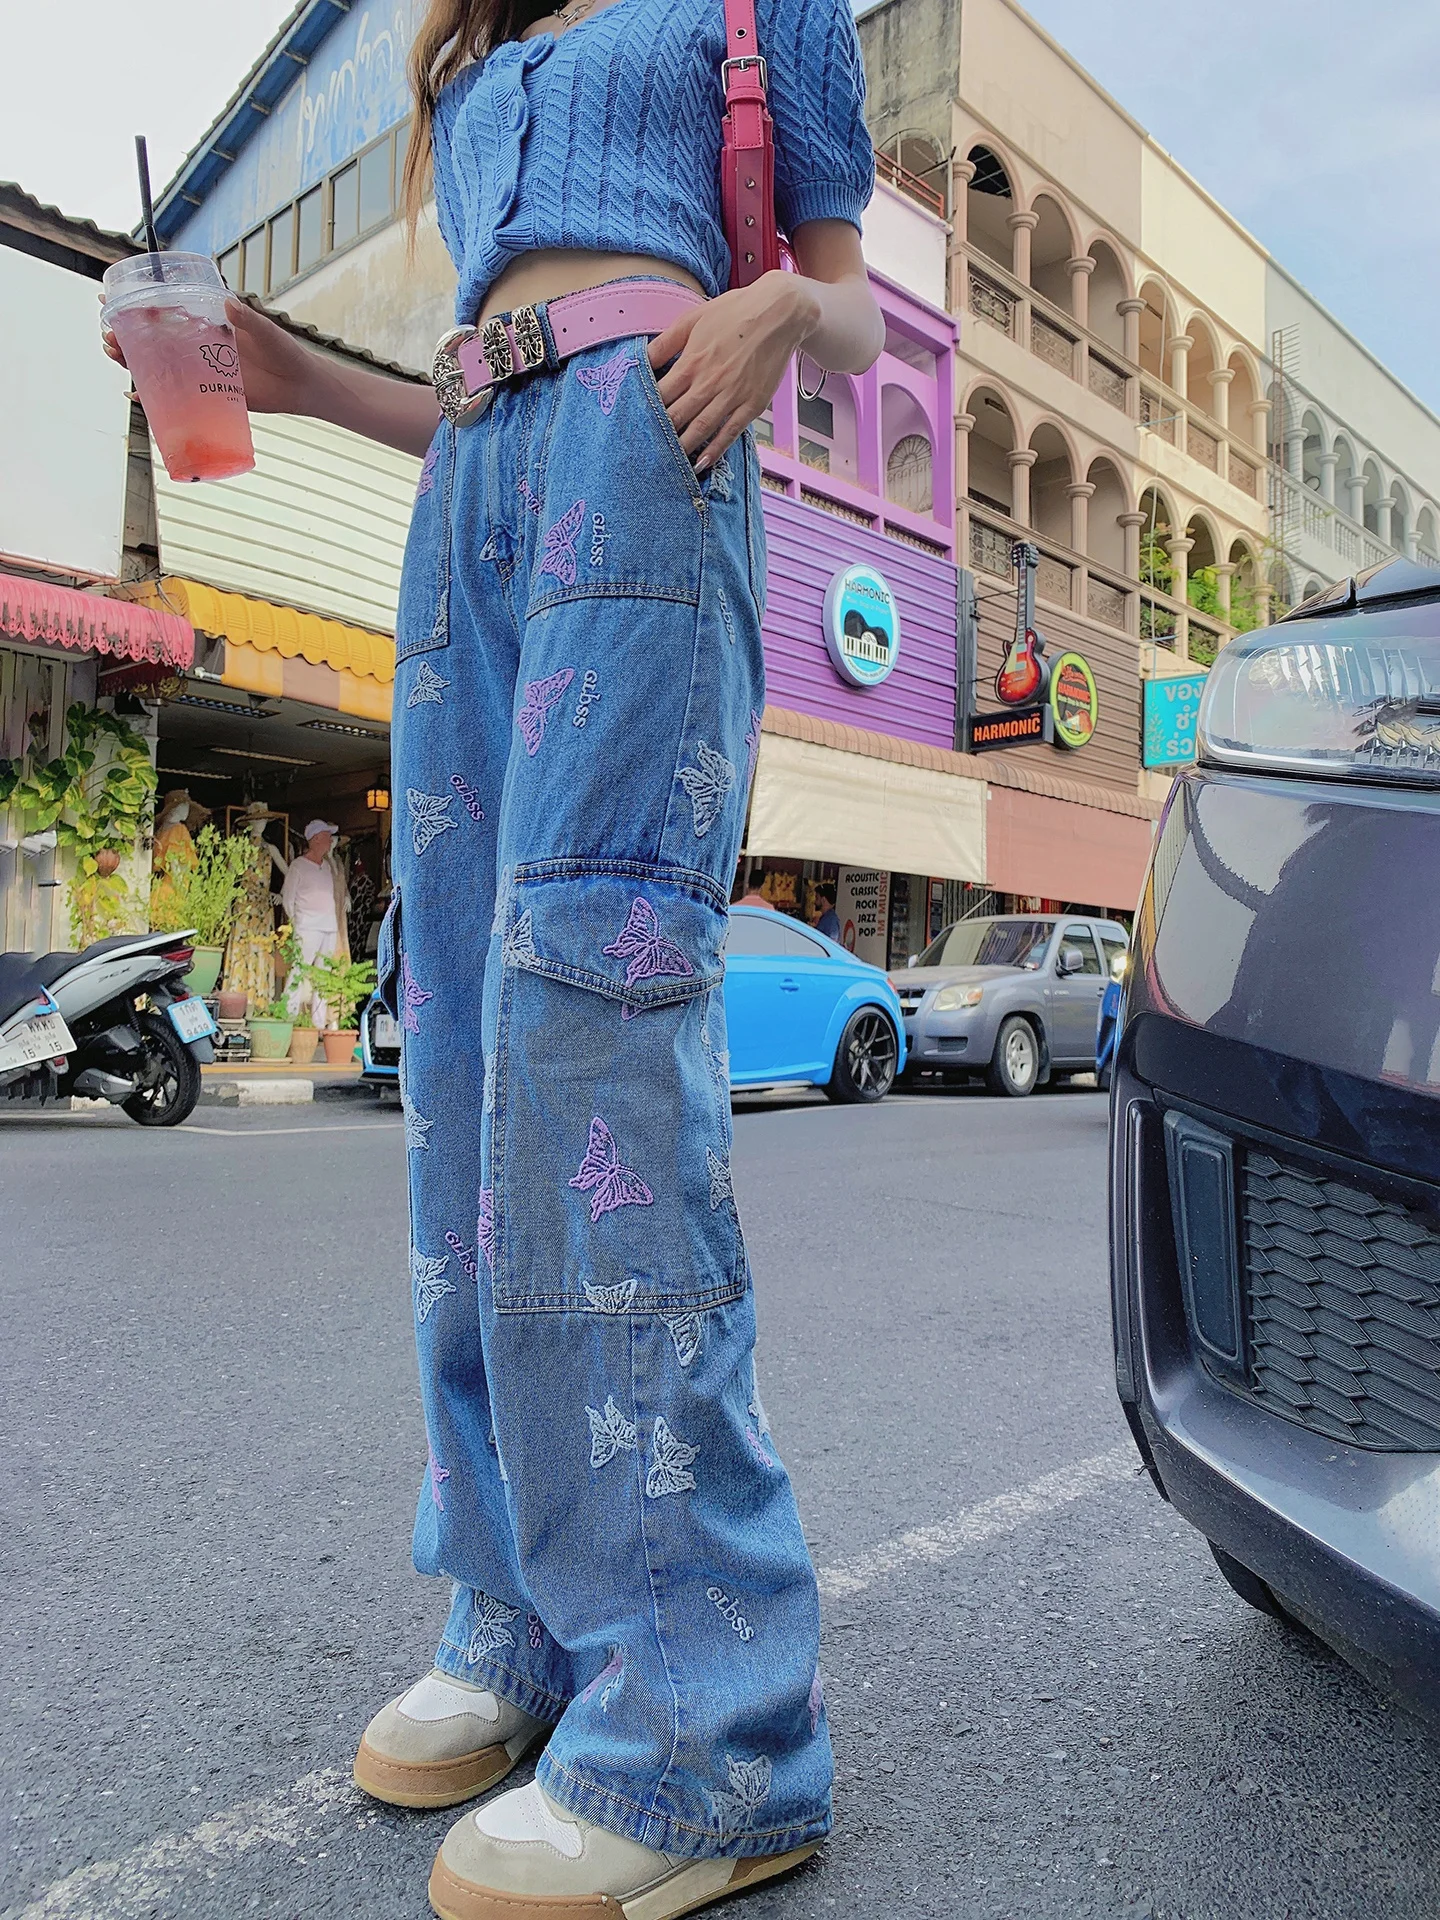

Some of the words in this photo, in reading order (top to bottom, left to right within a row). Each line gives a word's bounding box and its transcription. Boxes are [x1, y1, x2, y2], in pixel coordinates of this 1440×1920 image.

[845, 578, 890, 604] HARMONIC
[974, 717, 1040, 742] HARMONIC
[845, 872, 880, 883] ACOUSTIC
[850, 886, 879, 896] CLASSIC
[878, 871, 888, 914] MUSIC
[855, 900, 877, 909] ROCK
[858, 914, 876, 923] JAZZ
[859, 928, 876, 937] POP
